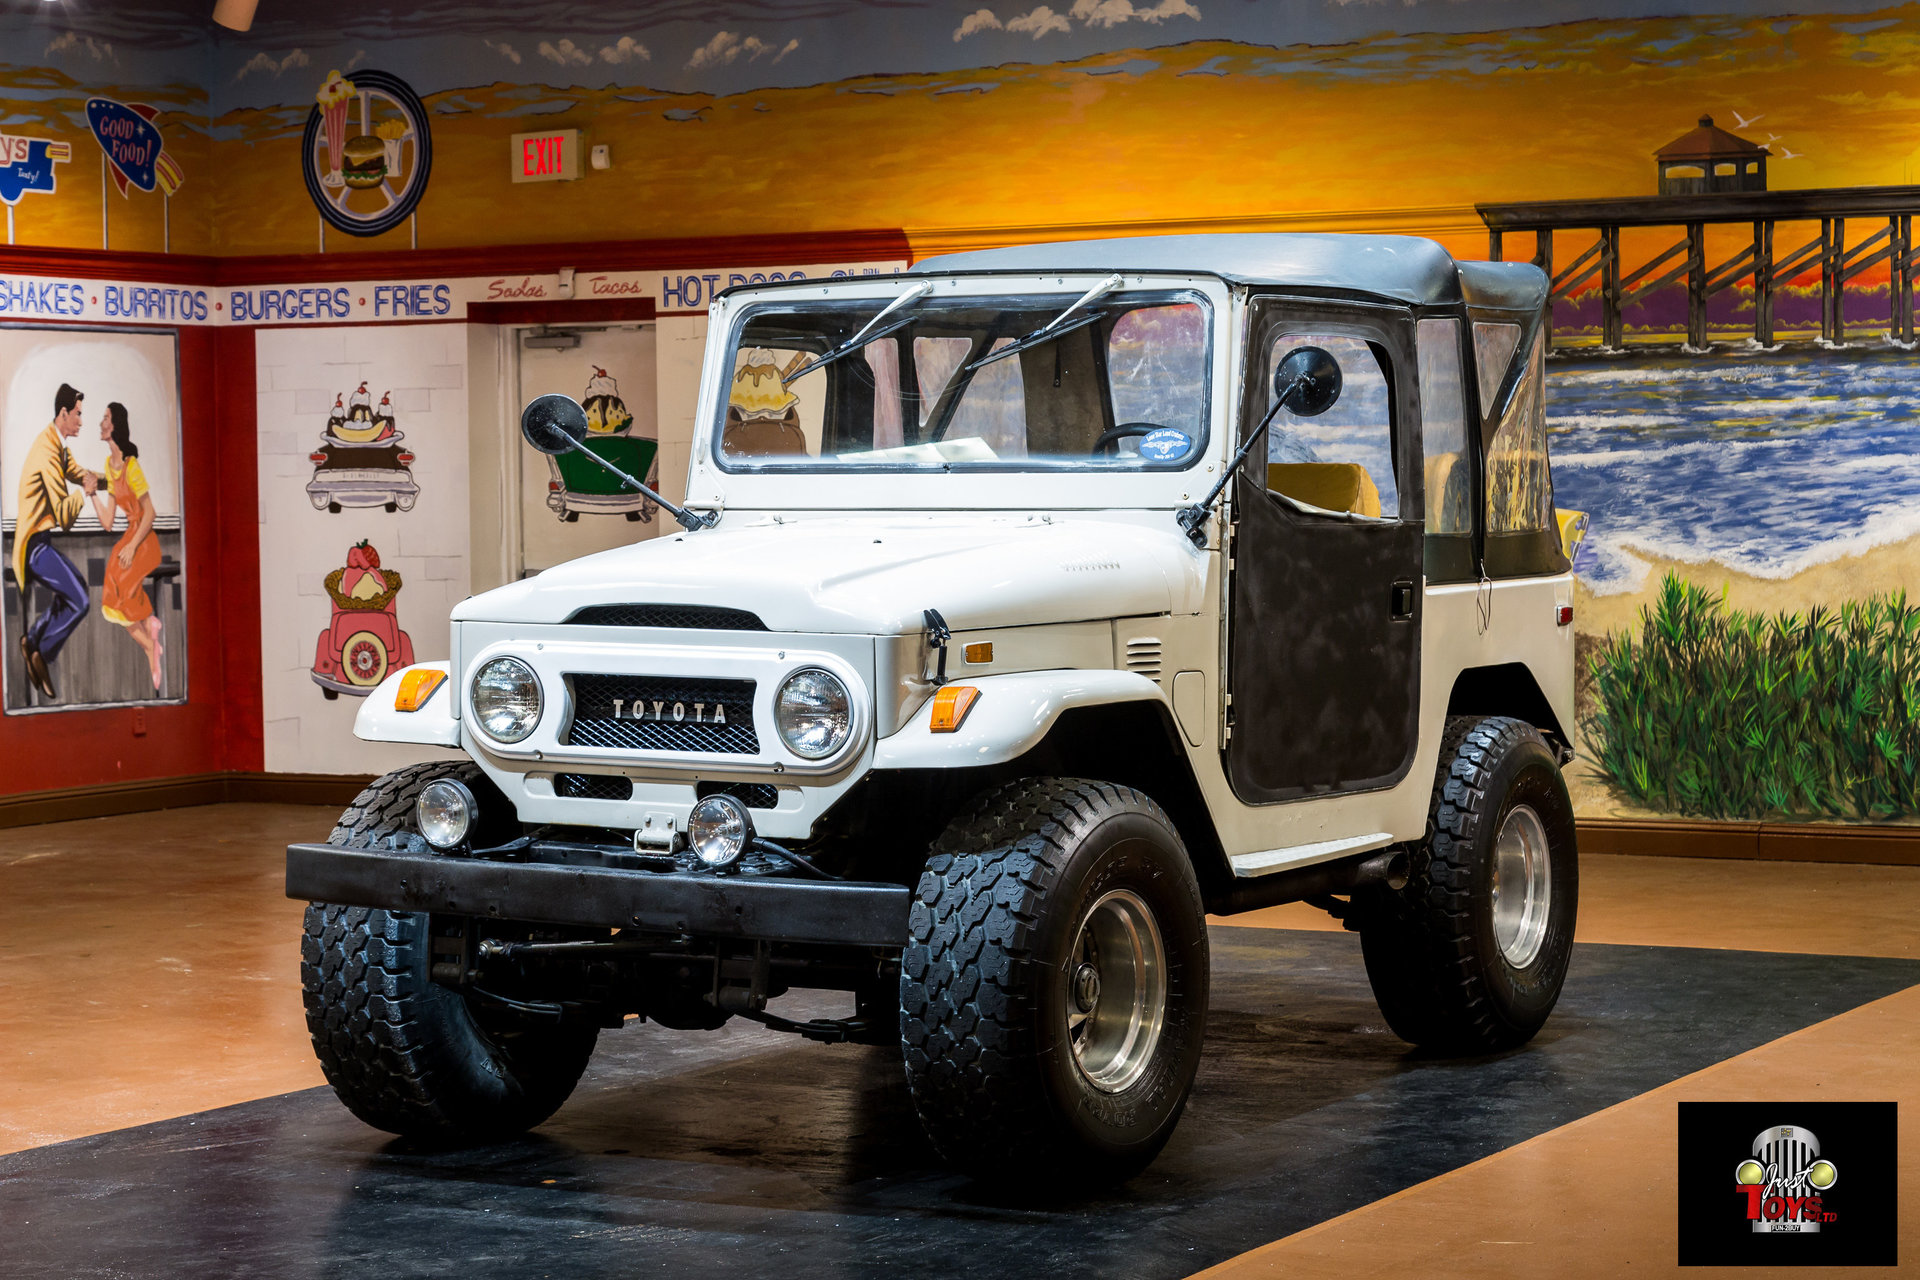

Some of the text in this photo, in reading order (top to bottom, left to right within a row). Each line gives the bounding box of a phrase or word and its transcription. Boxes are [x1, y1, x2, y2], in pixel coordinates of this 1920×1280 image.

[100, 115, 135, 140] GOOD
[111, 138, 153, 168] FOOD!
[523, 135, 565, 176] EXIT
[104, 285, 208, 321] BURRITOS
[231, 287, 351, 322] BURGERS
[374, 284, 451, 317] FRIES
[589, 275, 643, 295] Tacos
[663, 273, 720, 308] HOT
[612, 699, 727, 724] TOYOTA
